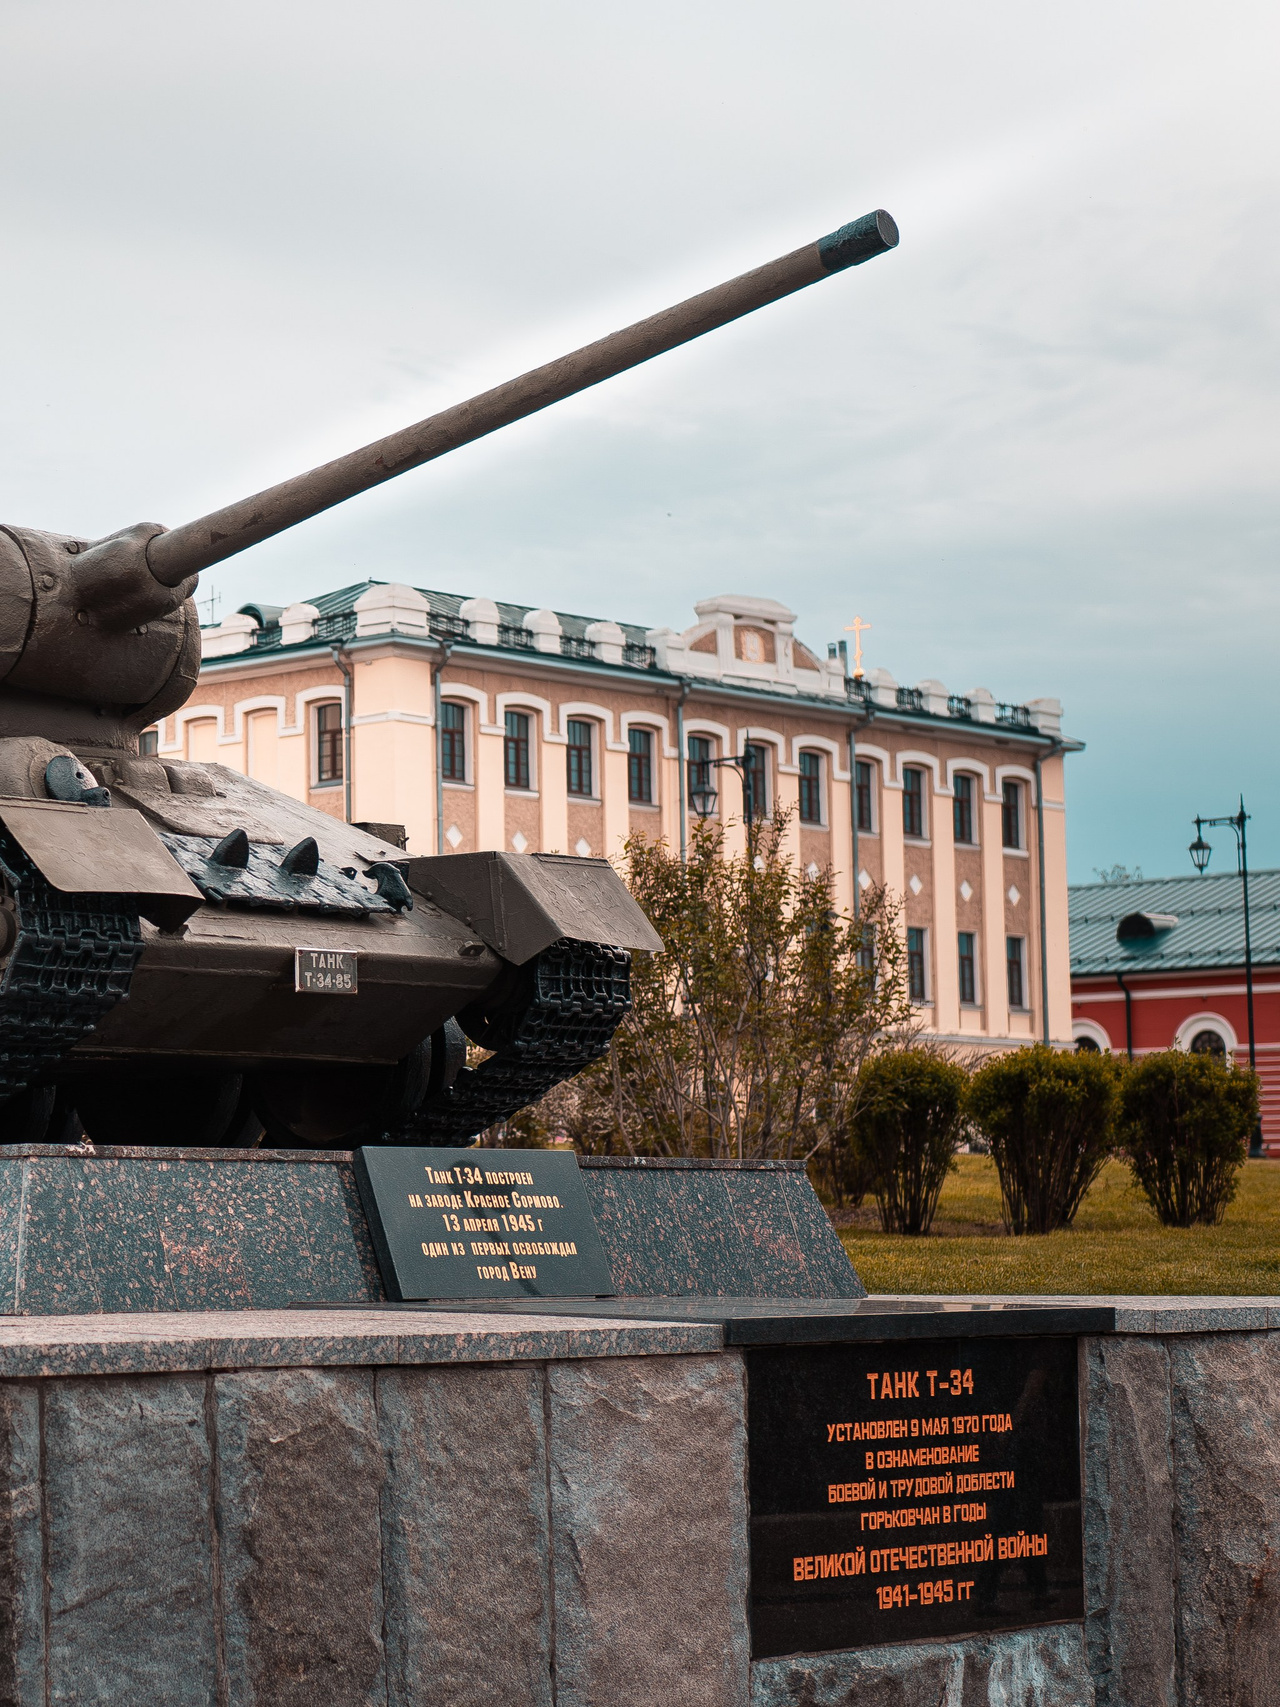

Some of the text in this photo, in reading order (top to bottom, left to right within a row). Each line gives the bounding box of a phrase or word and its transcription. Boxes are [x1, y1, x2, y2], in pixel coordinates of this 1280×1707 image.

[310, 952, 344, 969] ТАНК
[453, 1167, 483, 1185] Т-34
[442, 1214, 461, 1232] 13
[501, 1214, 536, 1232] 1945
[866, 1368, 974, 1400] ТАНК Т-34
[826, 1413, 1013, 1443] УСТАНОВЛЕН 9 МАЯ 1970 ГОДА
[865, 1444, 980, 1470] В ОЗНАМЕНОВАНИЕ
[827, 1470, 1015, 1504] БОЕВОЙ И ТРУДОВОЙ ДОБЛЕСТИ
[860, 1502, 987, 1531] ГОРЬКОВЧАН В ГОДЫ
[793, 1530, 1048, 1581] ВЕЛИКОЙ ОТЕЧЕСТВЕННОЙ ВОЙНЫ
[875, 1579, 954, 1610] 1941-1945
